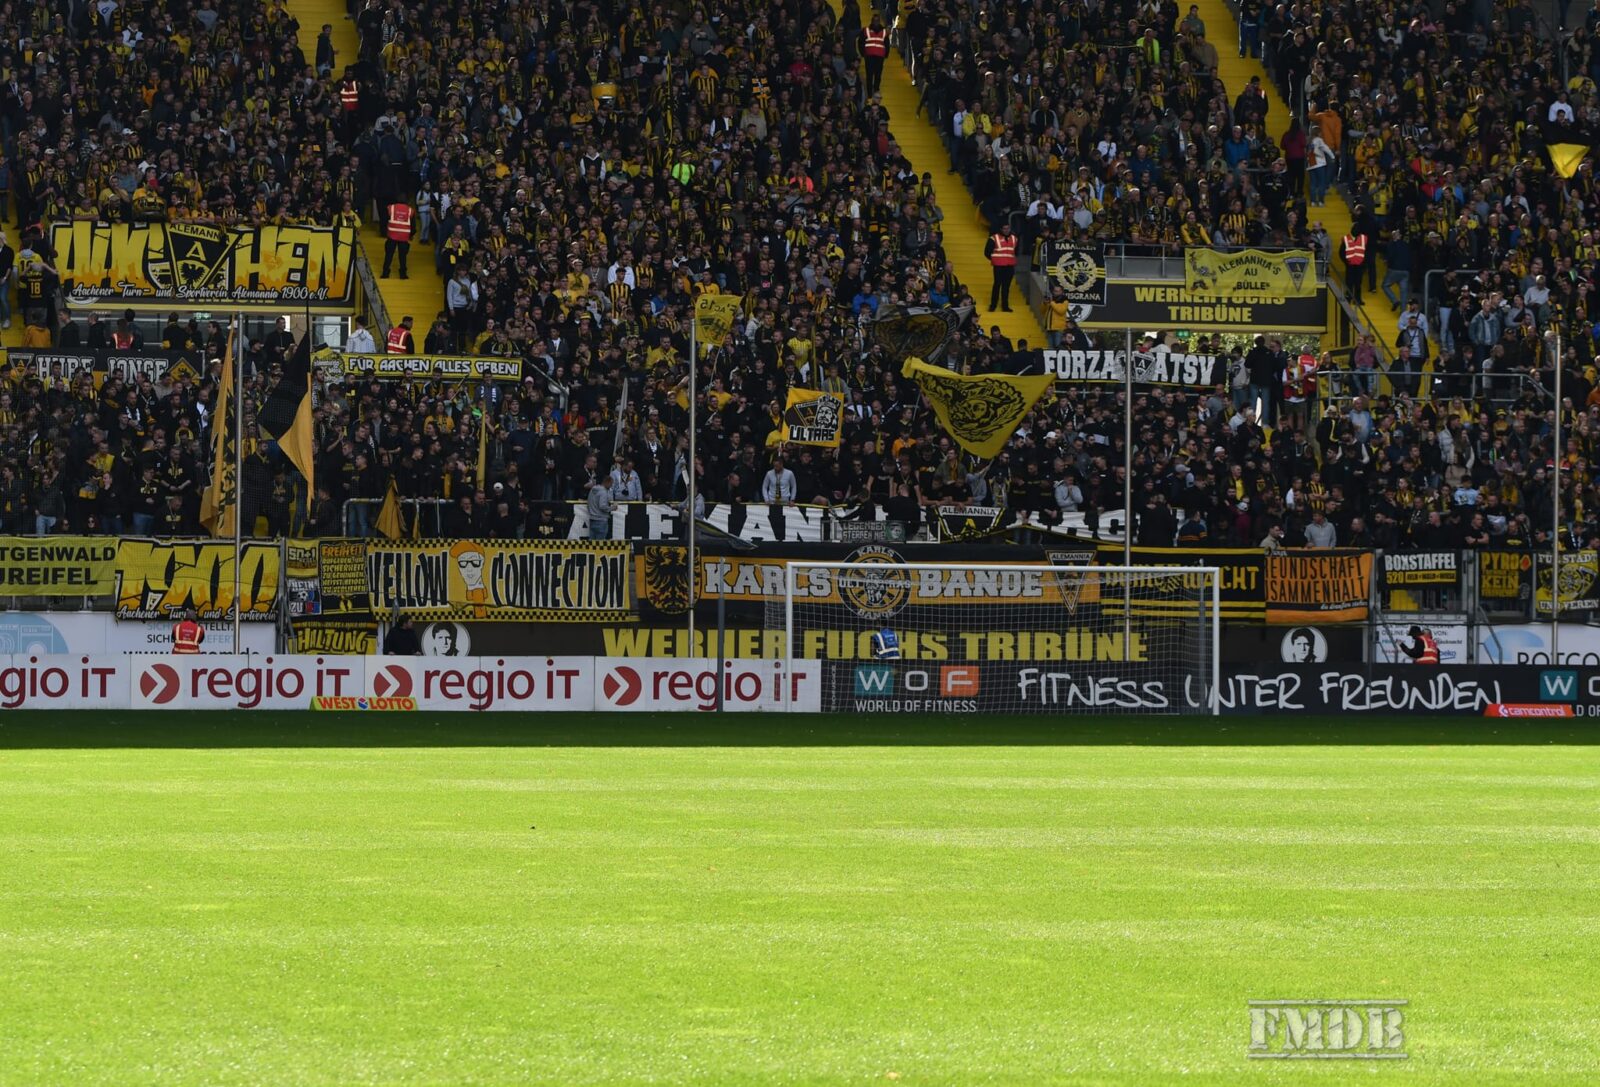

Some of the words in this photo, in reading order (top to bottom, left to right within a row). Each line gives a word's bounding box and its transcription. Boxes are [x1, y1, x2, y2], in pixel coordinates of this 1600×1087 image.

[156, 287, 173, 298] und
[232, 286, 278, 299] Alemannia
[282, 286, 308, 300] 1900
[1168, 305, 1252, 322] TRIBÜNE
[380, 358, 430, 372] AACHEN
[434, 360, 471, 374] ALLES
[1043, 350, 1116, 380] FORZA
[1154, 352, 1216, 385] ATSV
[1384, 553, 1456, 571] BOXSTAFFEL
[1481, 552, 1520, 570] PYRO
[368, 551, 448, 608] YELLOW
[492, 552, 625, 608] CONNECTION
[704, 563, 832, 598] KARLS
[918, 566, 1043, 598] BANDE
[1482, 576, 1518, 588] KEIN
[116, 605, 160, 620] Aachener
[204, 609, 222, 619] und
[602, 628, 786, 658] WERNER
[960, 626, 1150, 662] TRIBÜNE
[192, 656, 304, 708] regio
[424, 659, 534, 710] regio
[652, 661, 762, 711] regio
[1018, 668, 1168, 708] FITNESS
[1184, 673, 1304, 710] UNTER
[1320, 672, 1501, 710] FREUNDEN
[318, 697, 356, 710] WEST
[370, 698, 414, 710] LOTTO
[856, 700, 899, 712] WORLD
[904, 700, 920, 712] OF
[925, 700, 976, 712] FITNESS
[1508, 706, 1566, 716] camcontrol
